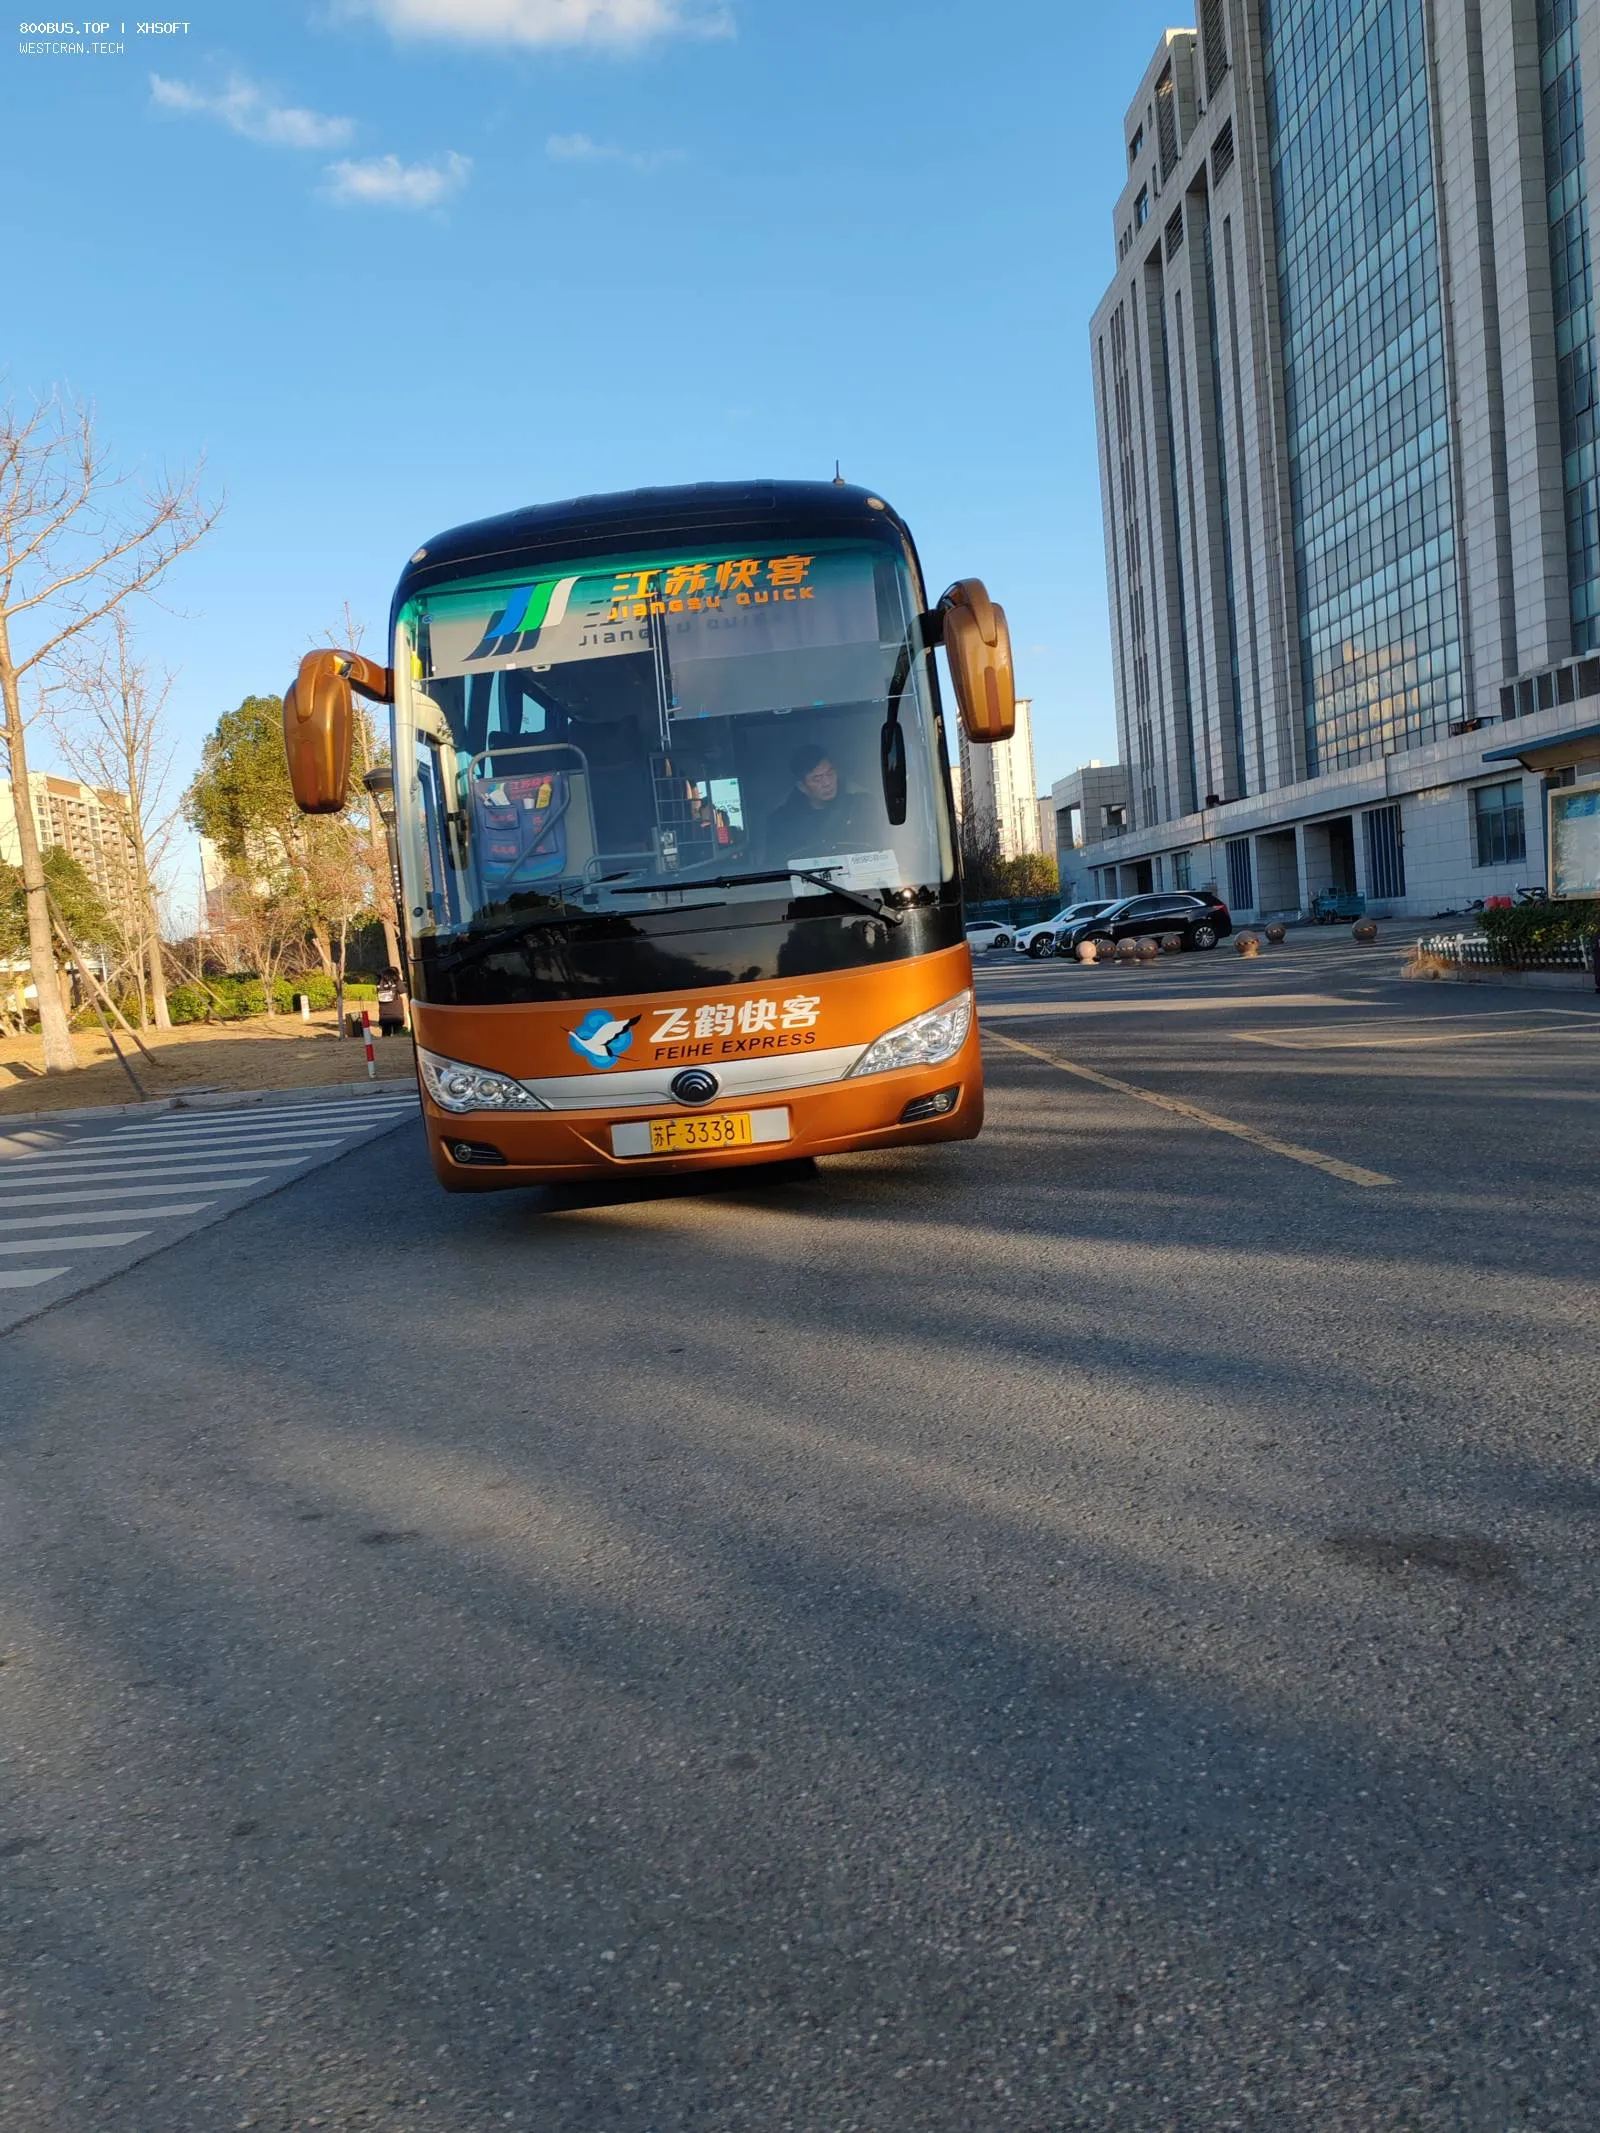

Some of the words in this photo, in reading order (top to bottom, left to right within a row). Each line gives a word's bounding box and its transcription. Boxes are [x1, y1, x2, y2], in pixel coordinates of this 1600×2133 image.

[611, 555, 816, 601] 江苏快客
[735, 586, 814, 606] QUICK
[649, 995, 821, 1044] 飞鹤快客
[654, 1042, 714, 1061] FEIHE
[721, 1031, 816, 1054] EXPRESS
